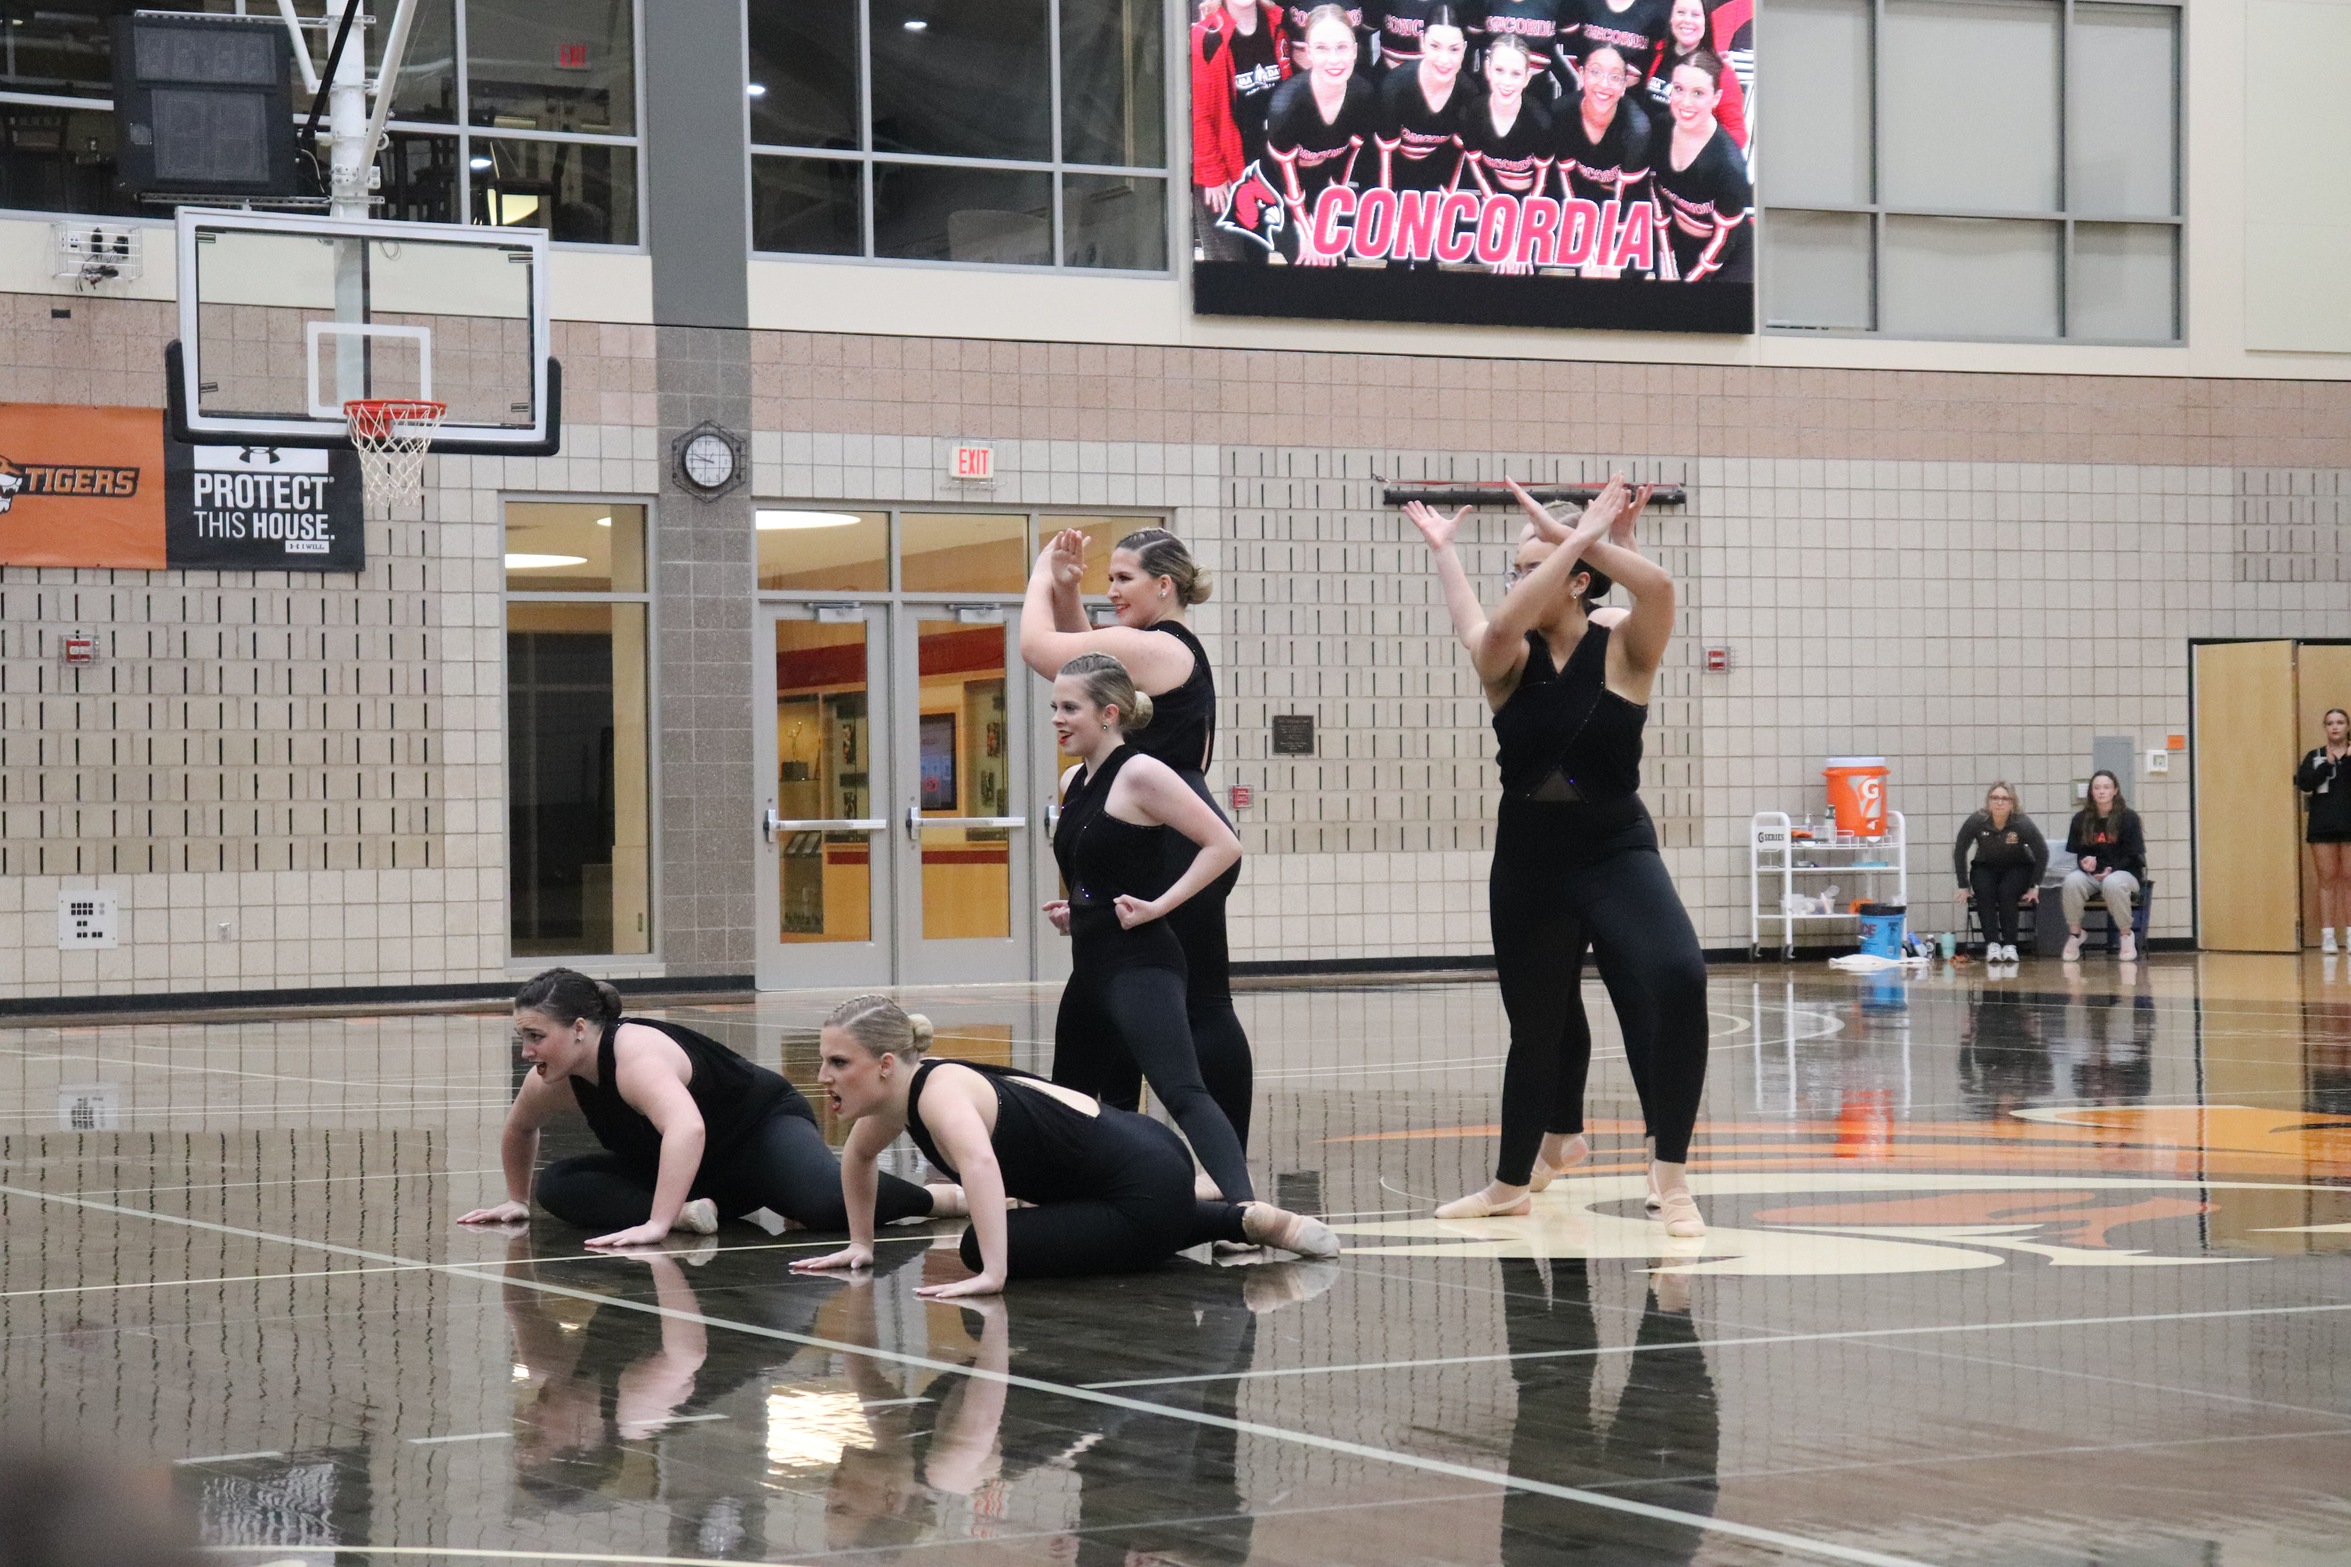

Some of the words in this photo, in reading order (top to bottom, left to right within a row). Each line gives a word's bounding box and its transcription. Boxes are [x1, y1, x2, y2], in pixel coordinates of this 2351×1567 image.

[1311, 184, 1653, 270] CONCORDIA
[959, 448, 989, 475] EXIT
[25, 467, 136, 494] TIGERS
[193, 511, 246, 538] THIS
[252, 512, 336, 540] HOUSE.
[1862, 778, 1880, 799] G
